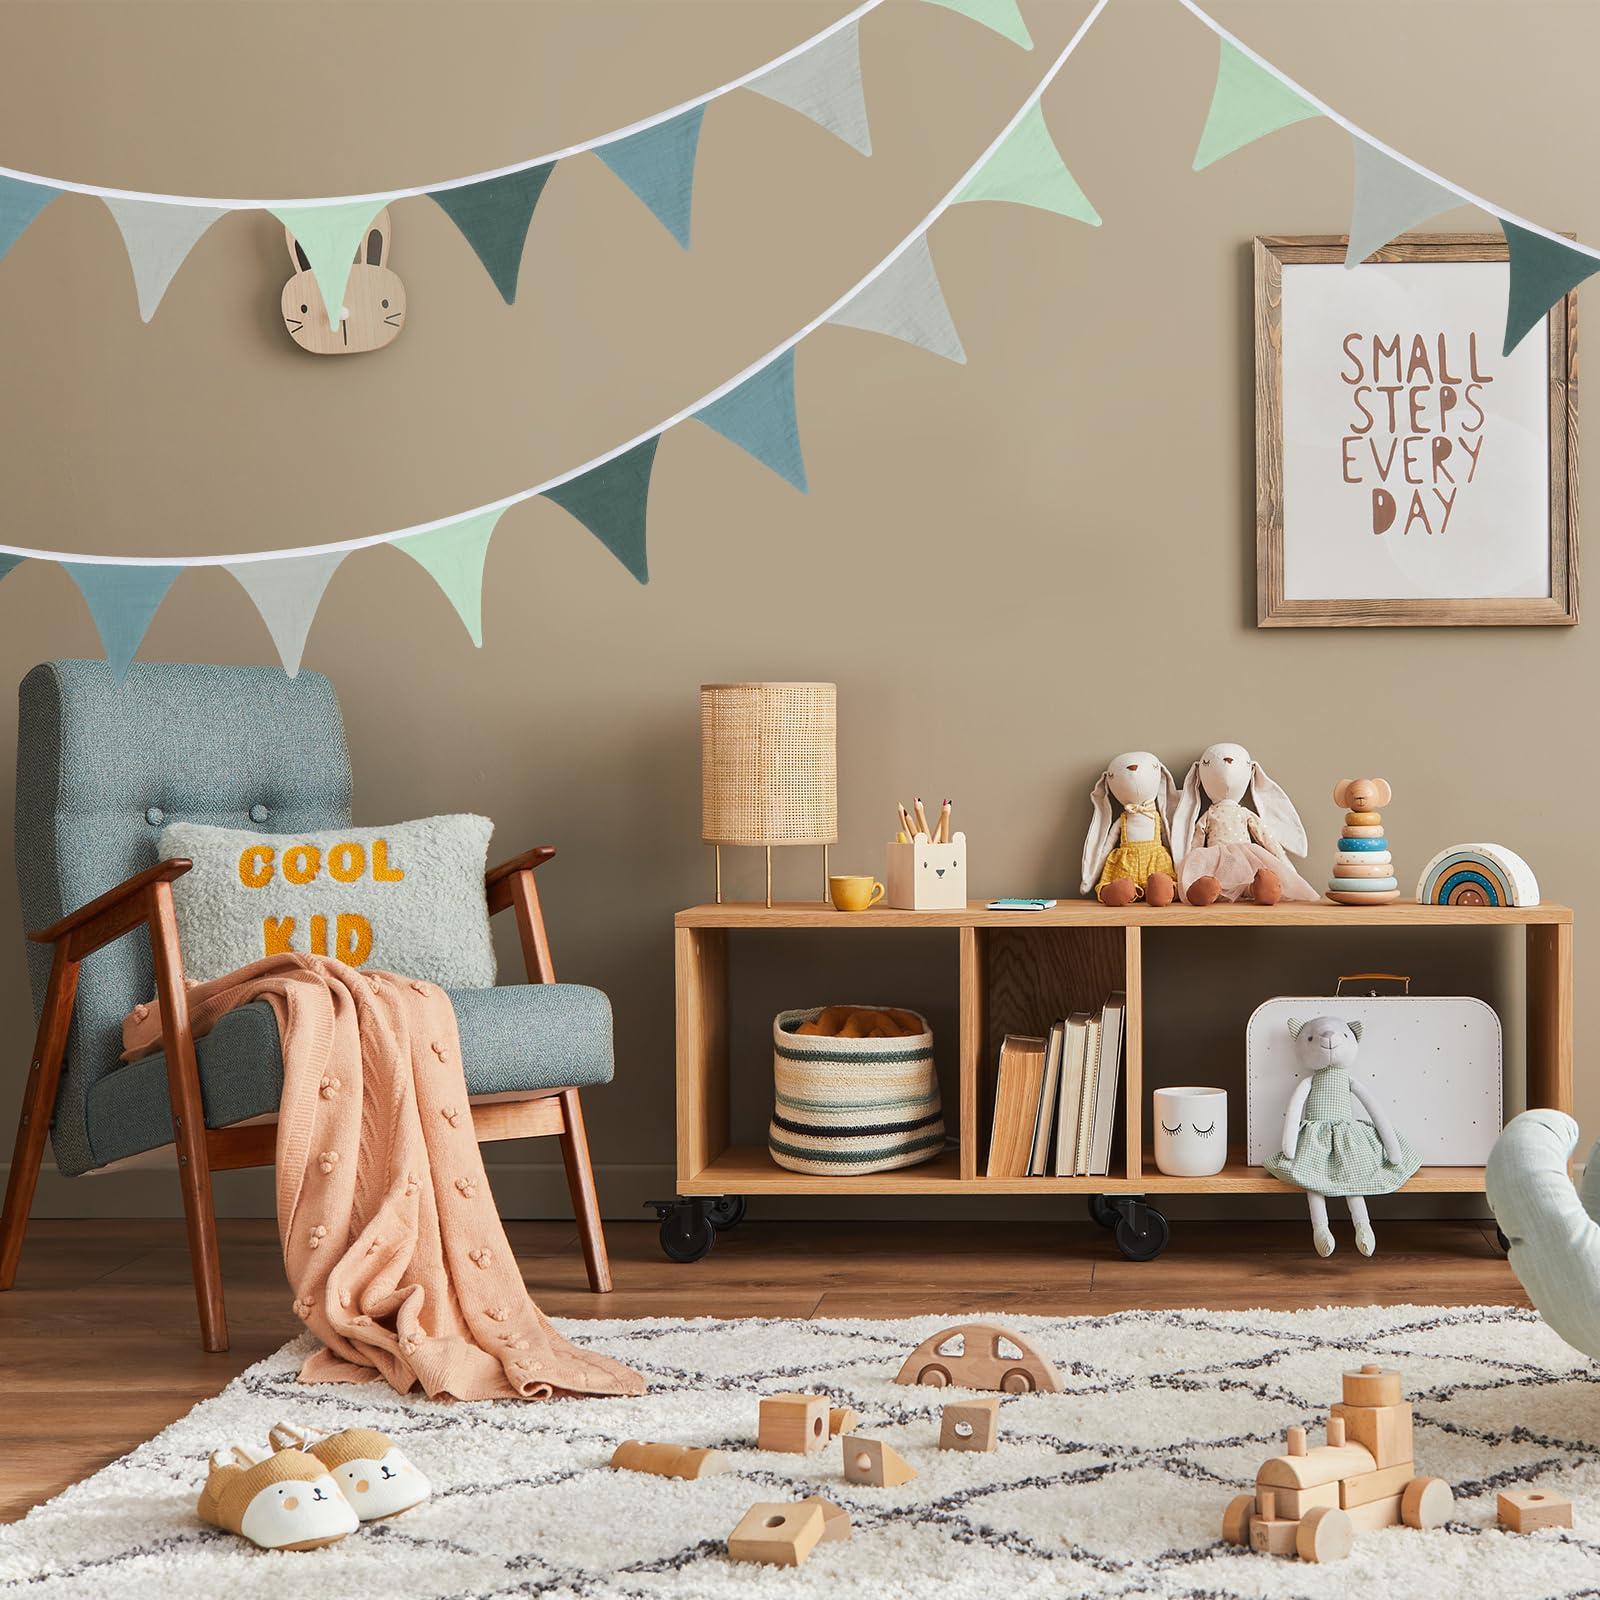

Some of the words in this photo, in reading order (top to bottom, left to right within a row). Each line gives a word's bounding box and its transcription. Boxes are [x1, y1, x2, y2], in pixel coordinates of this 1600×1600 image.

[1341, 332, 1493, 385] SMALL
[1350, 384, 1484, 433] STEPS
[1342, 435, 1483, 484] EVERY
[1372, 487, 1457, 535] DAY
[239, 839, 405, 888] COOL
[263, 913, 373, 968] KID
